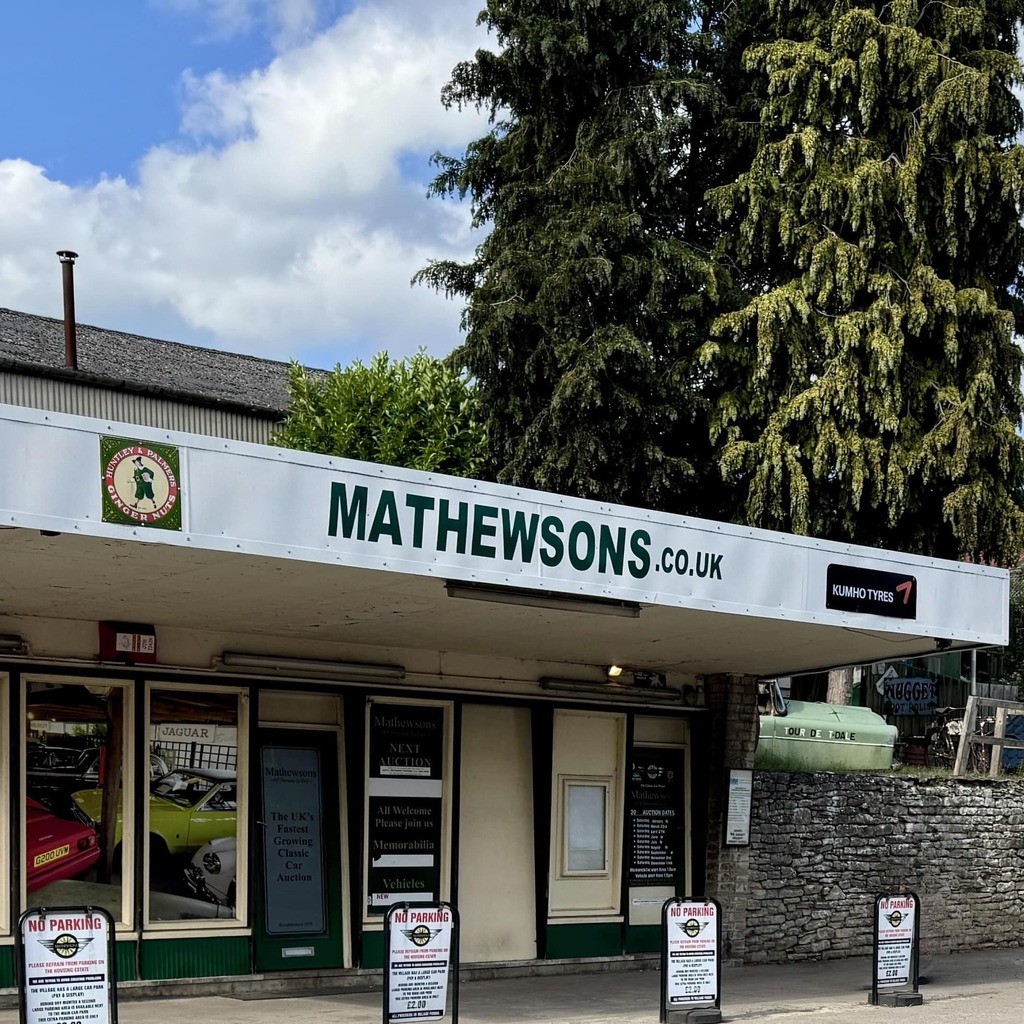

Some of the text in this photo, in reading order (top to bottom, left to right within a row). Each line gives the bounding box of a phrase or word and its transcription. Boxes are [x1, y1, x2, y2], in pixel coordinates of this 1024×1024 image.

[106, 446, 134, 478] HUNTLEY
[147, 450, 176, 487] PALMERS
[108, 485, 175, 520] GINGER NUTS
[832, 584, 894, 603] KUMHO TYRES
[375, 716, 436, 729] Mathewsons
[162, 727, 208, 738] JAGUAR
[784, 727, 806, 736] TOUR
[810, 729, 822, 738] DE
[390, 744, 421, 753] NEXT
[379, 757, 432, 766] AUCTION
[265, 767, 316, 778] Mathewsons
[377, 806, 432, 815] All Welcome
[271, 812, 288, 821] The
[278, 824, 308, 833] Fastest
[376, 819, 403, 827] Please
[405, 819, 421, 829] join
[274, 836, 313, 847] Growing
[373, 840, 434, 850] Memorabilia
[36, 851, 54, 864] G200
[278, 849, 309, 858] Classic
[286, 861, 302, 870] Car
[276, 873, 312, 882] Auction
[383, 879, 425, 889] Vehicles
[881, 900, 913, 909] NO PARKING
[395, 912, 449, 923] NO PARKING
[671, 908, 714, 917] NO PARKING
[28, 918, 101, 932] NO PARKING
[407, 1001, 426, 1009] £2.00
